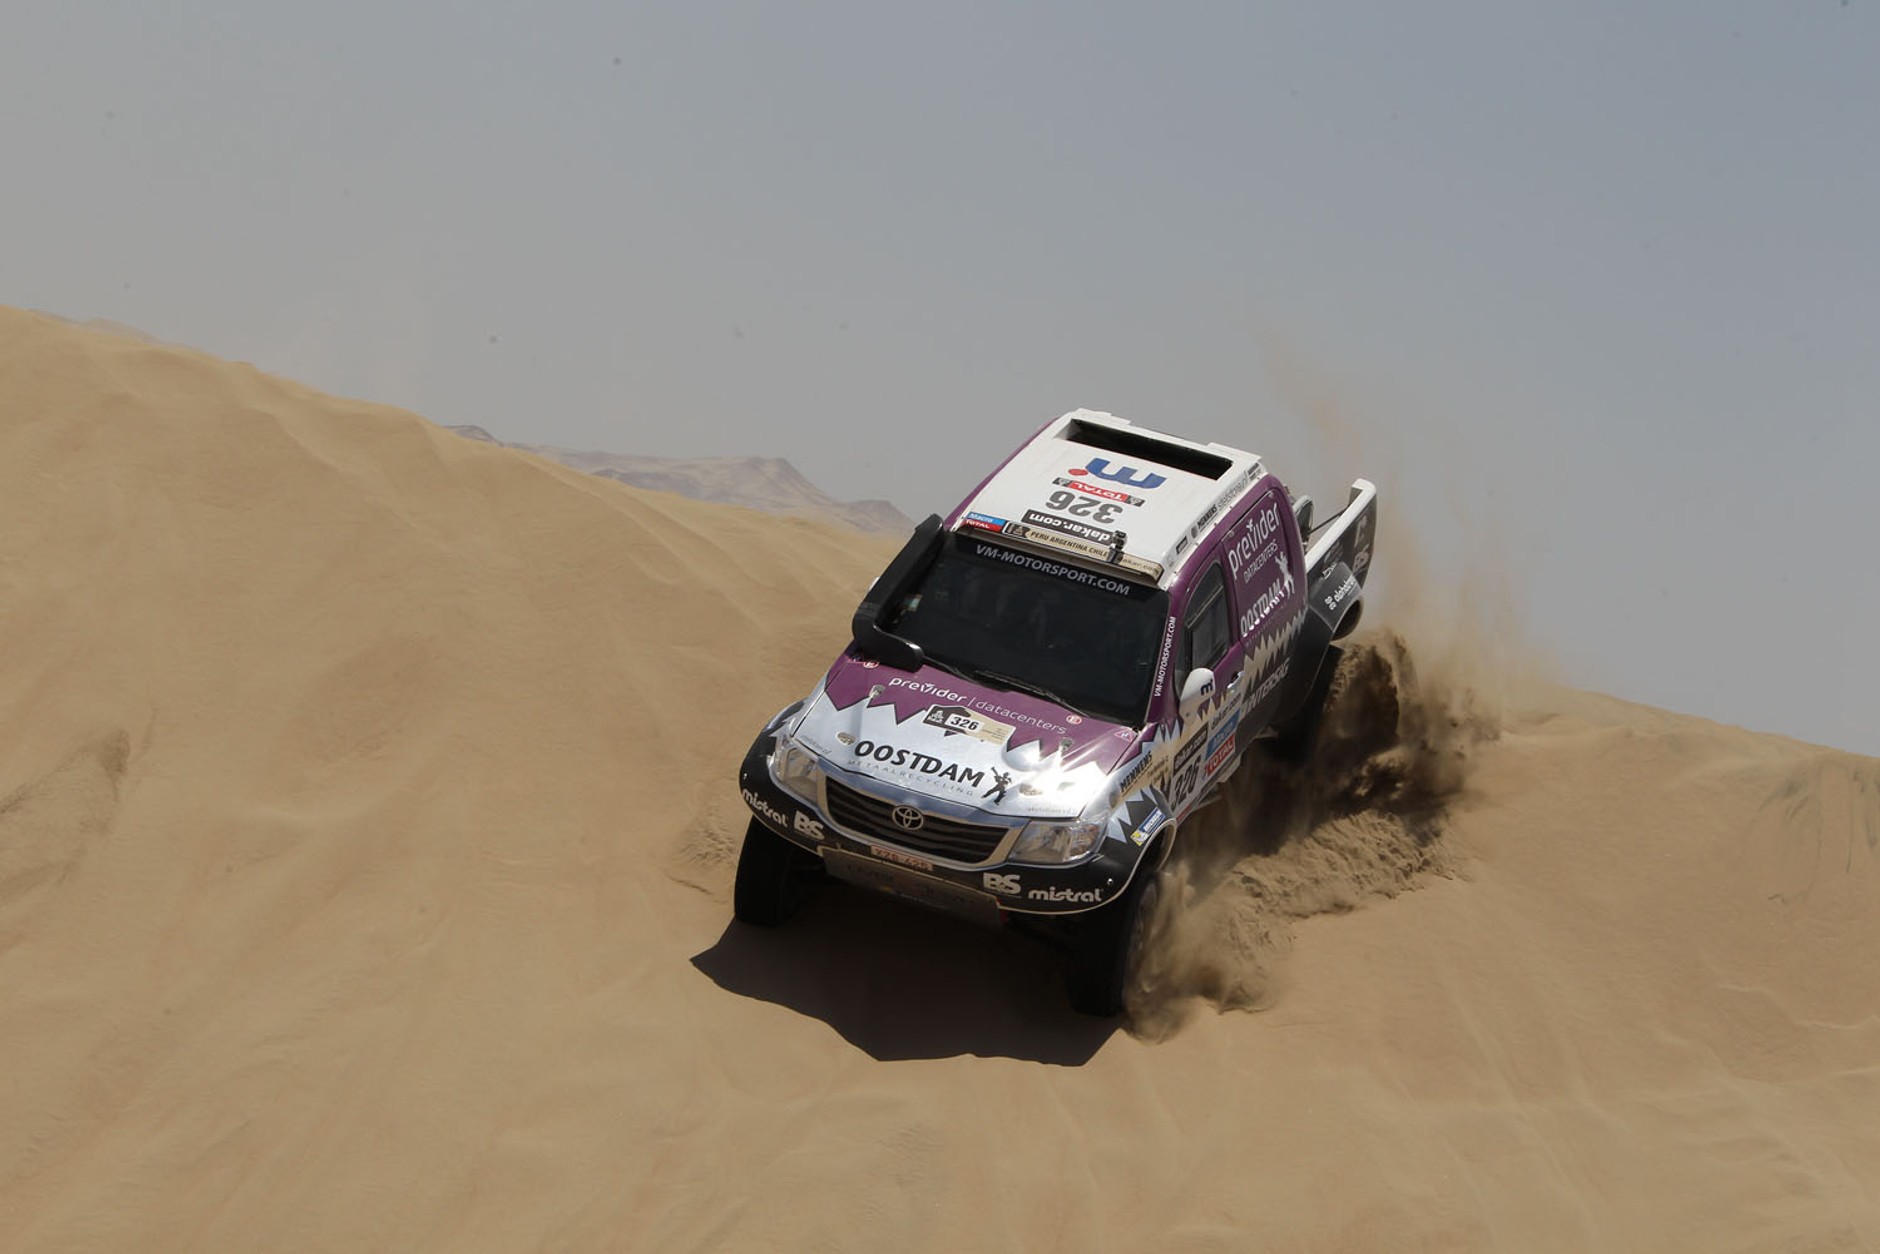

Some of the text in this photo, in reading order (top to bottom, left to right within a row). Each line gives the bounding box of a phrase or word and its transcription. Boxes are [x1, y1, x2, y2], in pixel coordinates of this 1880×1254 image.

[1045, 490, 1124, 524] 326
[1074, 481, 1123, 501] TOTAL
[965, 518, 990, 529] TOTAL
[1029, 513, 1112, 543] dakar.com
[1030, 531, 1050, 542] PERU
[1050, 535, 1088, 552] ARGENTINA
[1228, 502, 1281, 580] previder
[975, 544, 1131, 596] VM-MOTORSPORT.COM
[1239, 578, 1286, 638] OOSTDAM
[1154, 616, 1177, 697] VM-MOTORSPORT.COM
[888, 677, 968, 704] previder
[975, 701, 1067, 735] datacenters
[950, 716, 980, 731] 326
[854, 740, 985, 788] OOSTDAM
[1119, 750, 1153, 793] MENNENS
[1208, 735, 1235, 773] TOTAL
[848, 759, 974, 797] METAALRECYCLING
[743, 788, 788, 828] mistral
[1028, 886, 1102, 902] mistral
